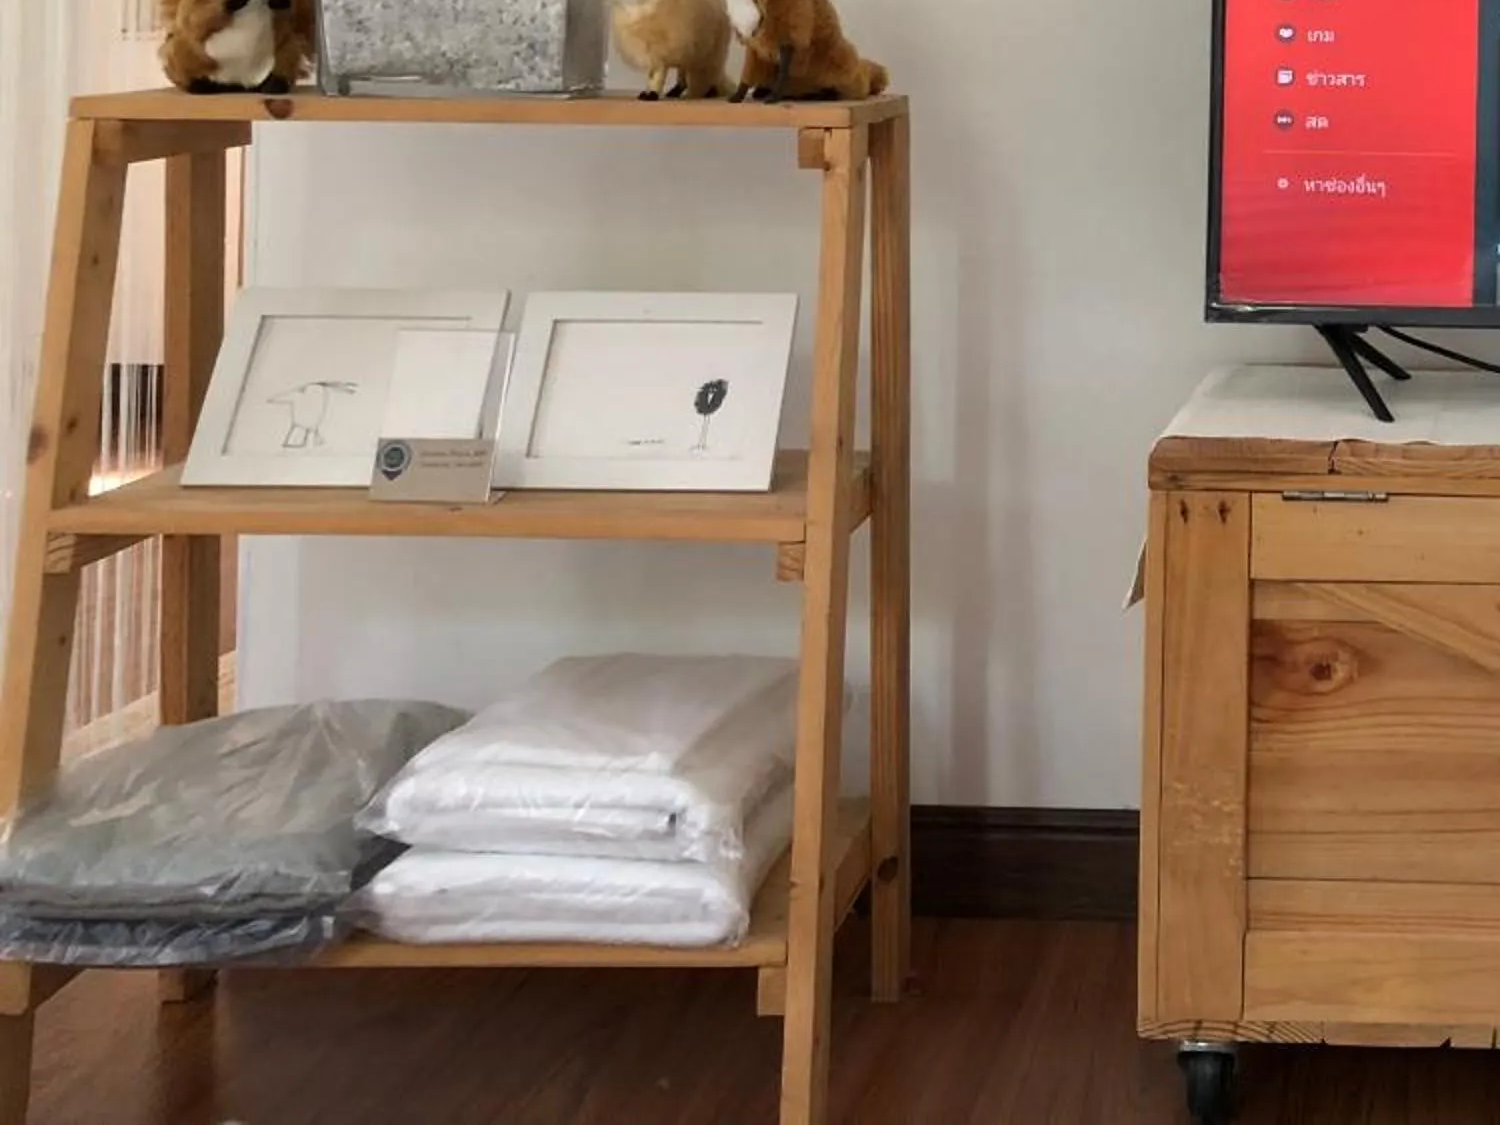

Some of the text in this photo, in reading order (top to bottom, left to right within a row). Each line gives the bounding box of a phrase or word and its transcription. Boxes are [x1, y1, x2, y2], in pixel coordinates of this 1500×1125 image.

[1306, 29, 1336, 43] เกม
[1305, 69, 1367, 88] ข่าวสาร
[1305, 115, 1329, 130] สด
[1303, 174, 1387, 198] หาช่องอื่นๆ
